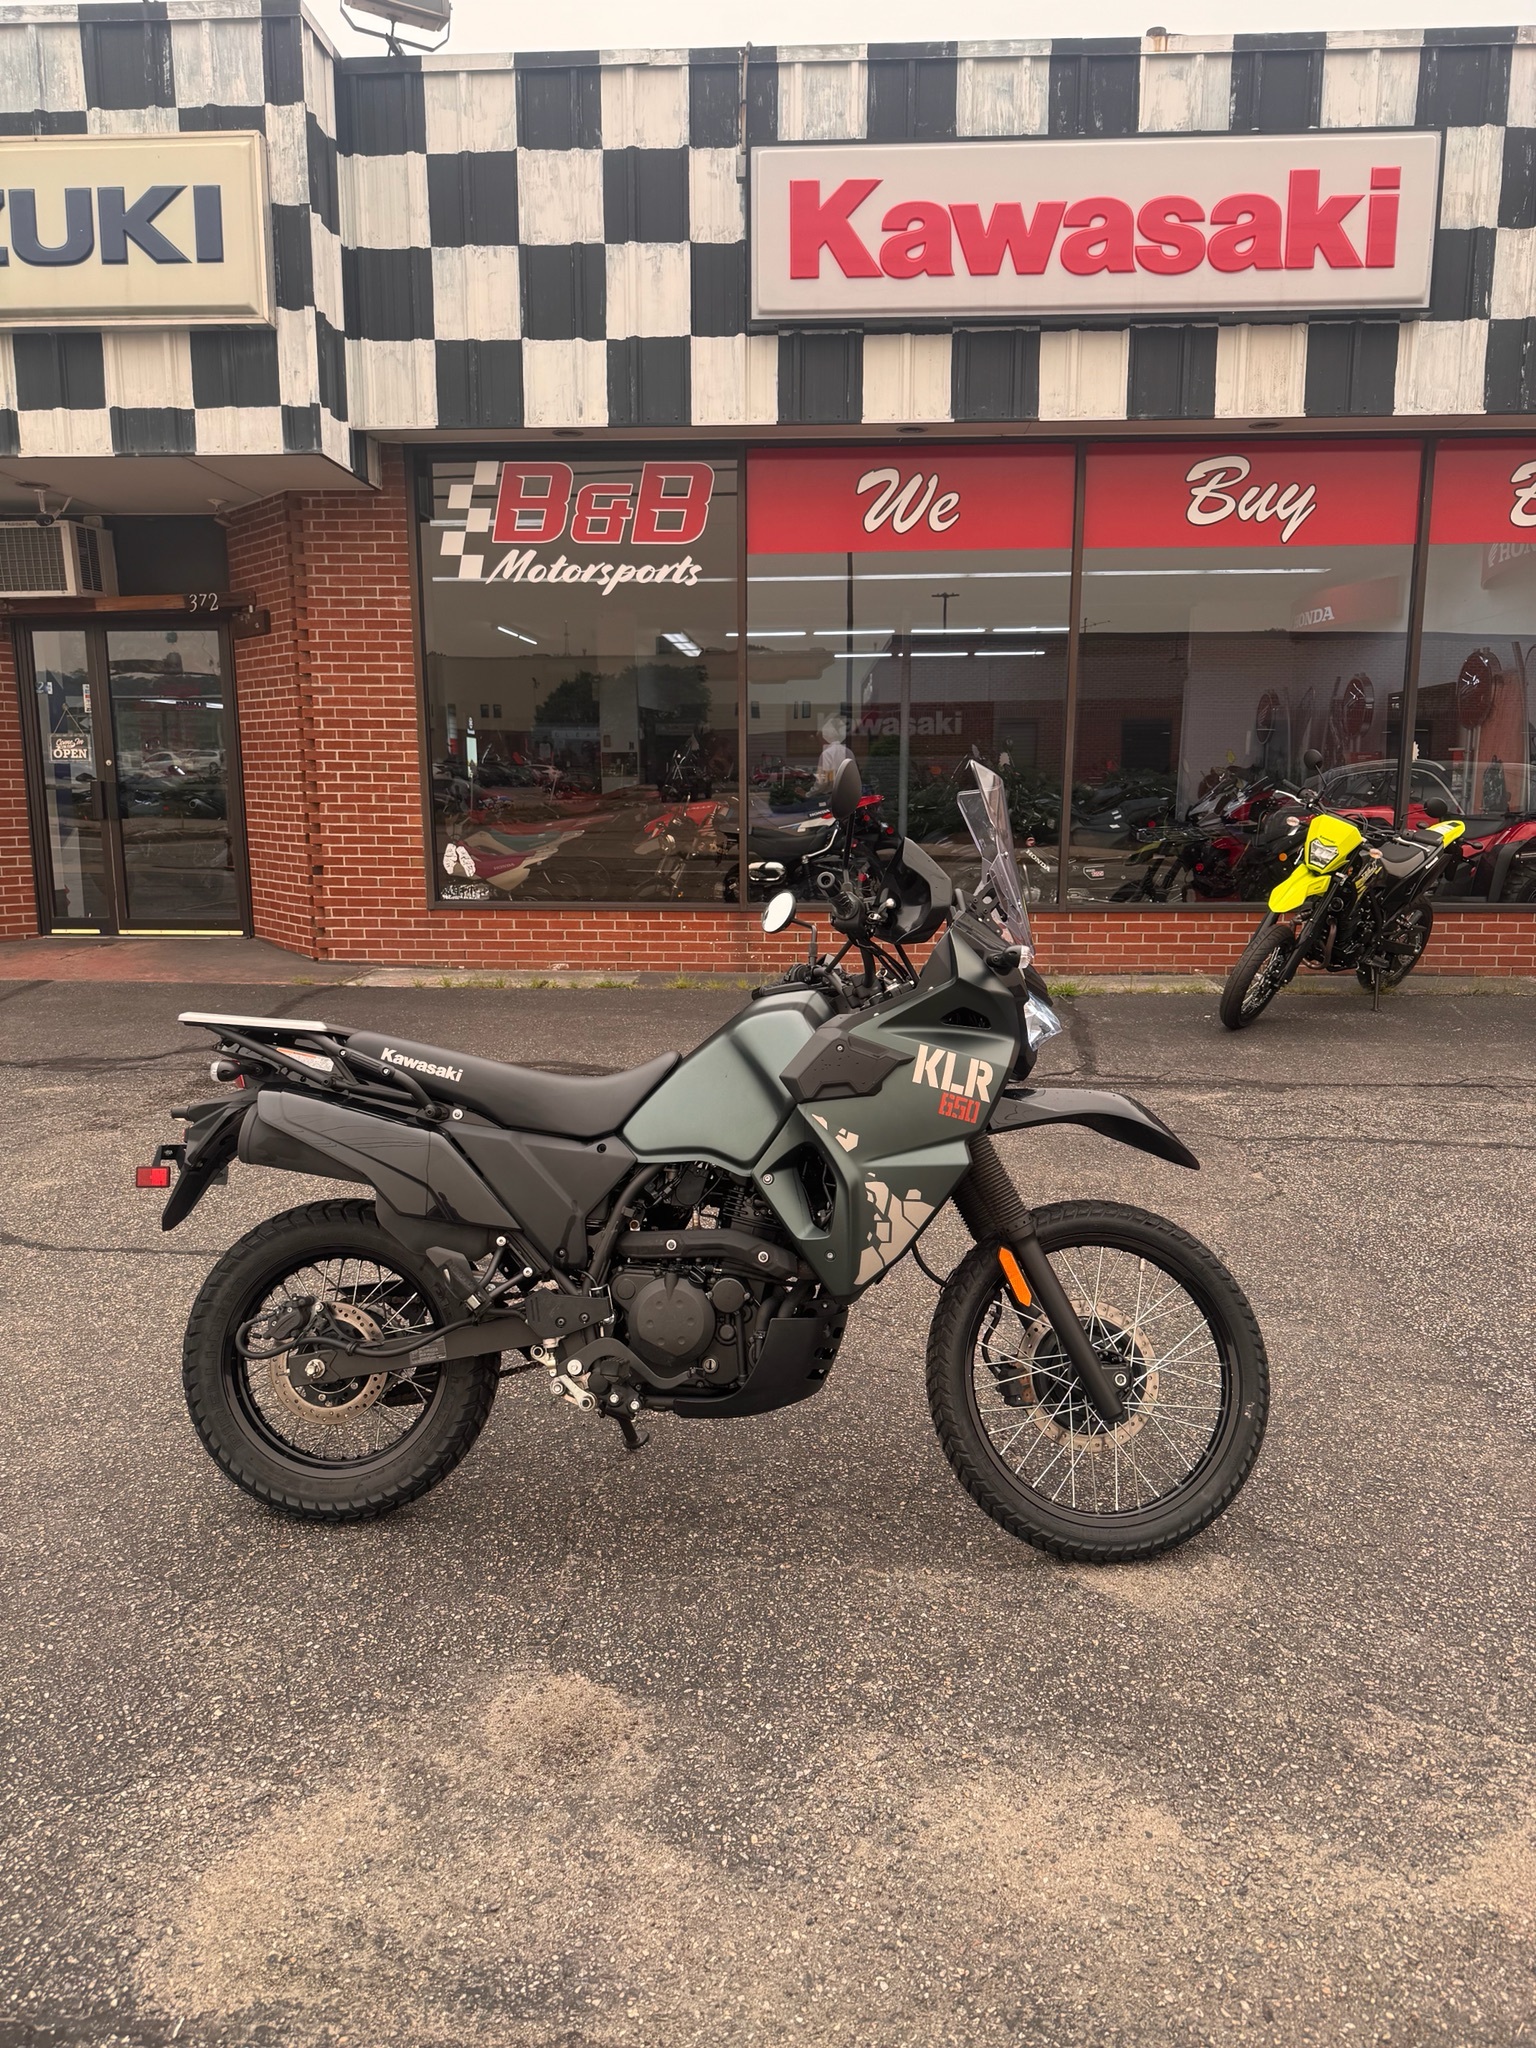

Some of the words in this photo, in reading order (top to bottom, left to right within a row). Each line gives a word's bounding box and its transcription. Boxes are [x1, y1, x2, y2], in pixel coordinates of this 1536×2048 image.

[0, 185, 224, 267] UKI
[789, 167, 1402, 279] Kawasaki
[492, 462, 715, 544] B&B
[856, 467, 960, 534] We
[1185, 455, 1317, 544] Buy
[485, 549, 702, 596] Motorsports
[189, 592, 219, 613] 372
[53, 748, 88, 759] OPEN
[1025, 848, 1051, 873] HONDA
[380, 1047, 464, 1083] Kawasaki
[912, 1044, 993, 1103] KLR
[938, 1091, 981, 1124] 650
